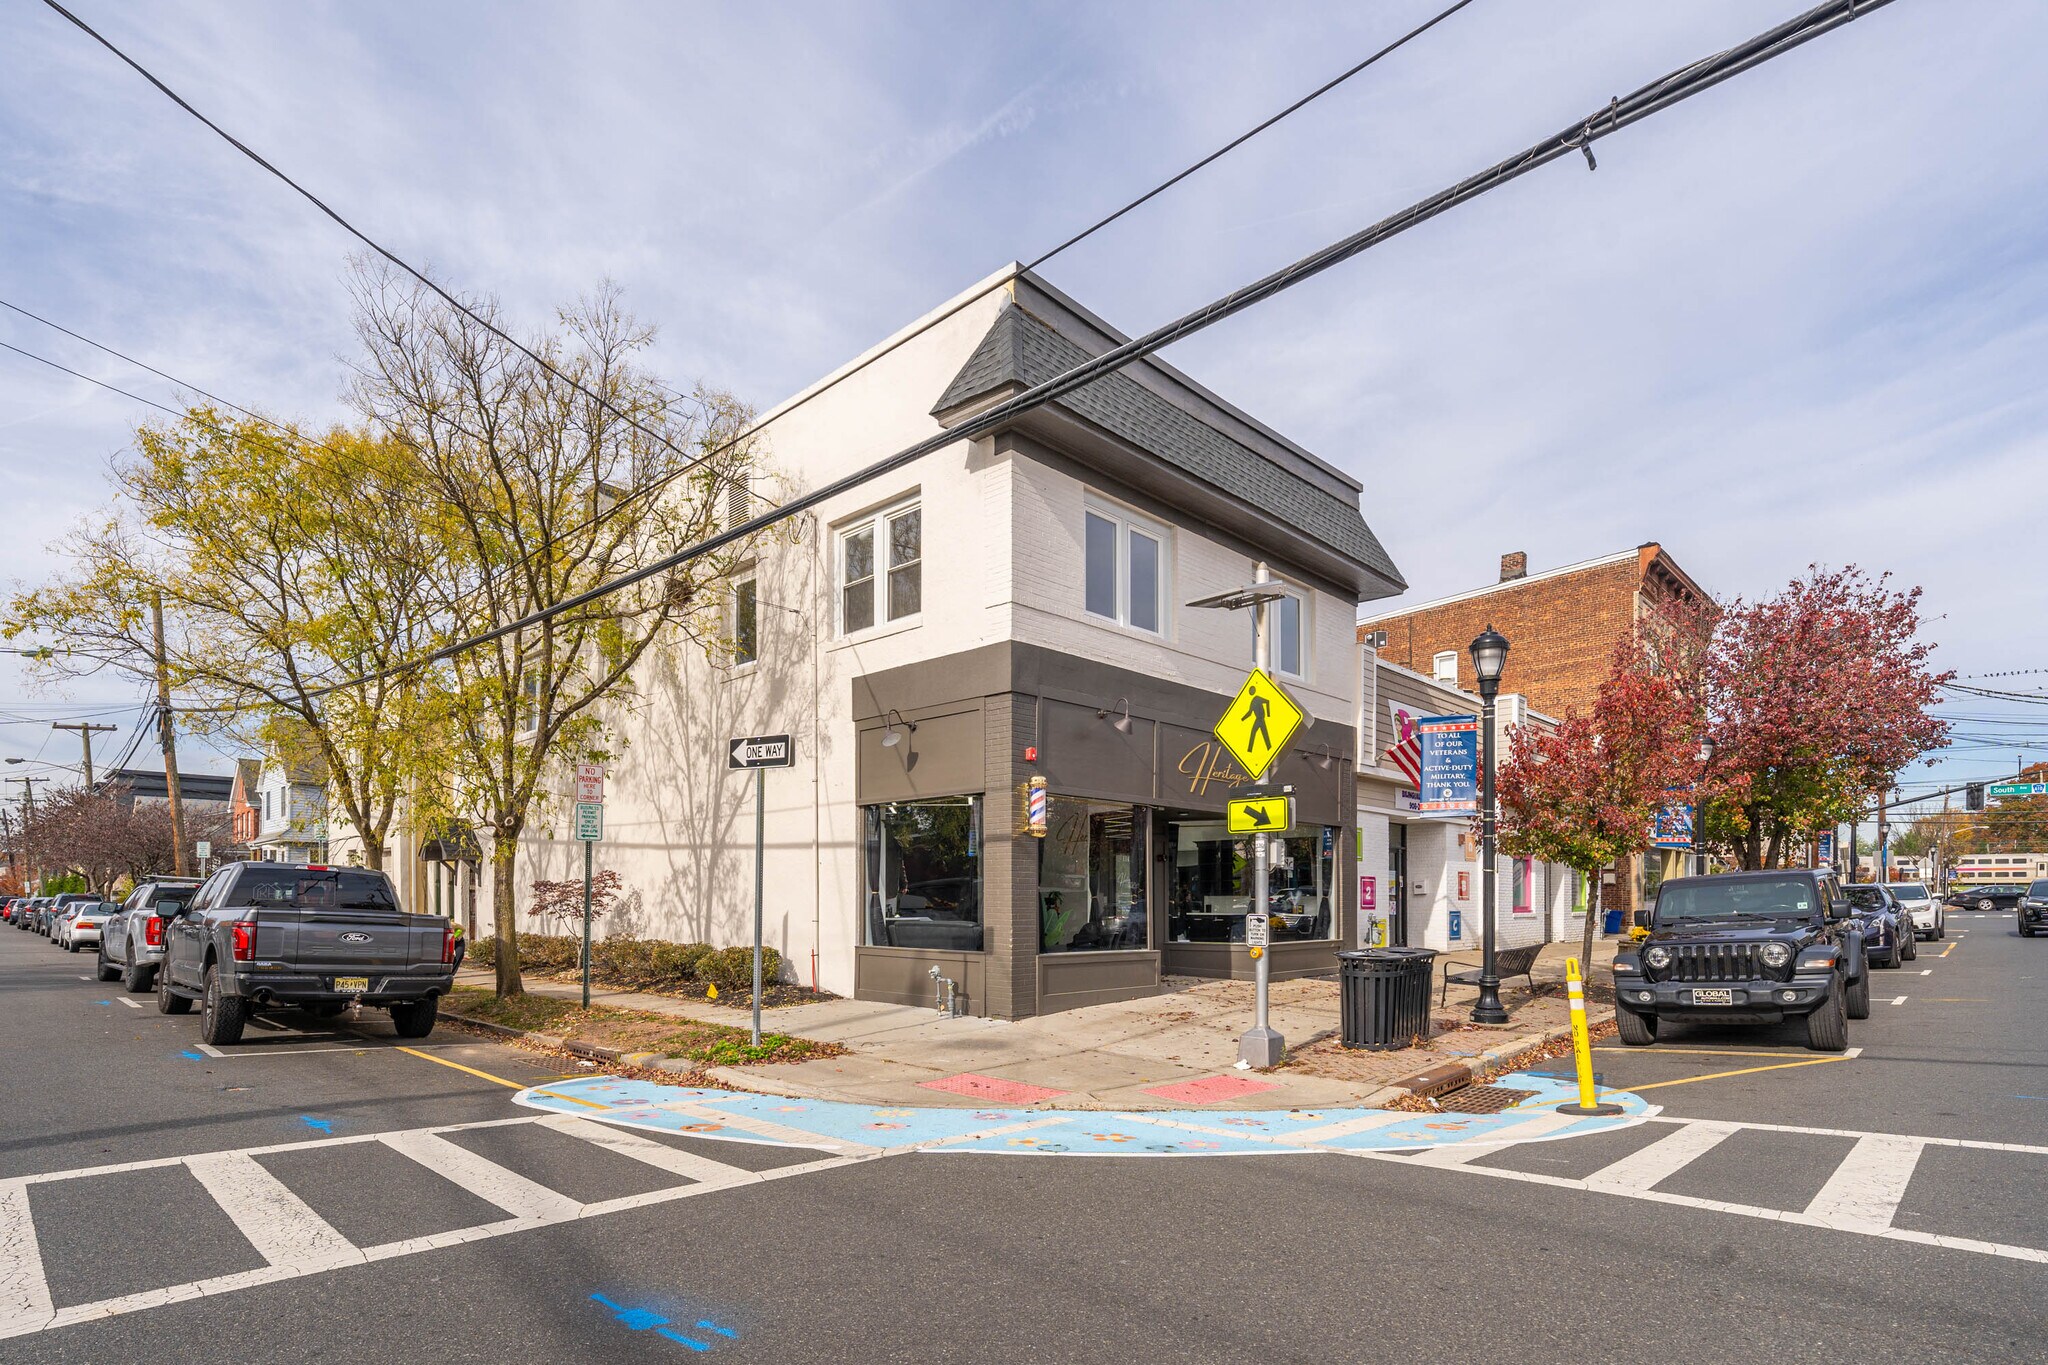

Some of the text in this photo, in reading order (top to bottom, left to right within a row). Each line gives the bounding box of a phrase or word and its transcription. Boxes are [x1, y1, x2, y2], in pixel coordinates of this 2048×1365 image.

[746, 744, 783, 758] ONE WAY
[1178, 741, 1249, 796] Heritage
[578, 776, 601, 784] PARKING
[1365, 886, 1371, 900] 2
[1453, 919, 1458, 931] C
